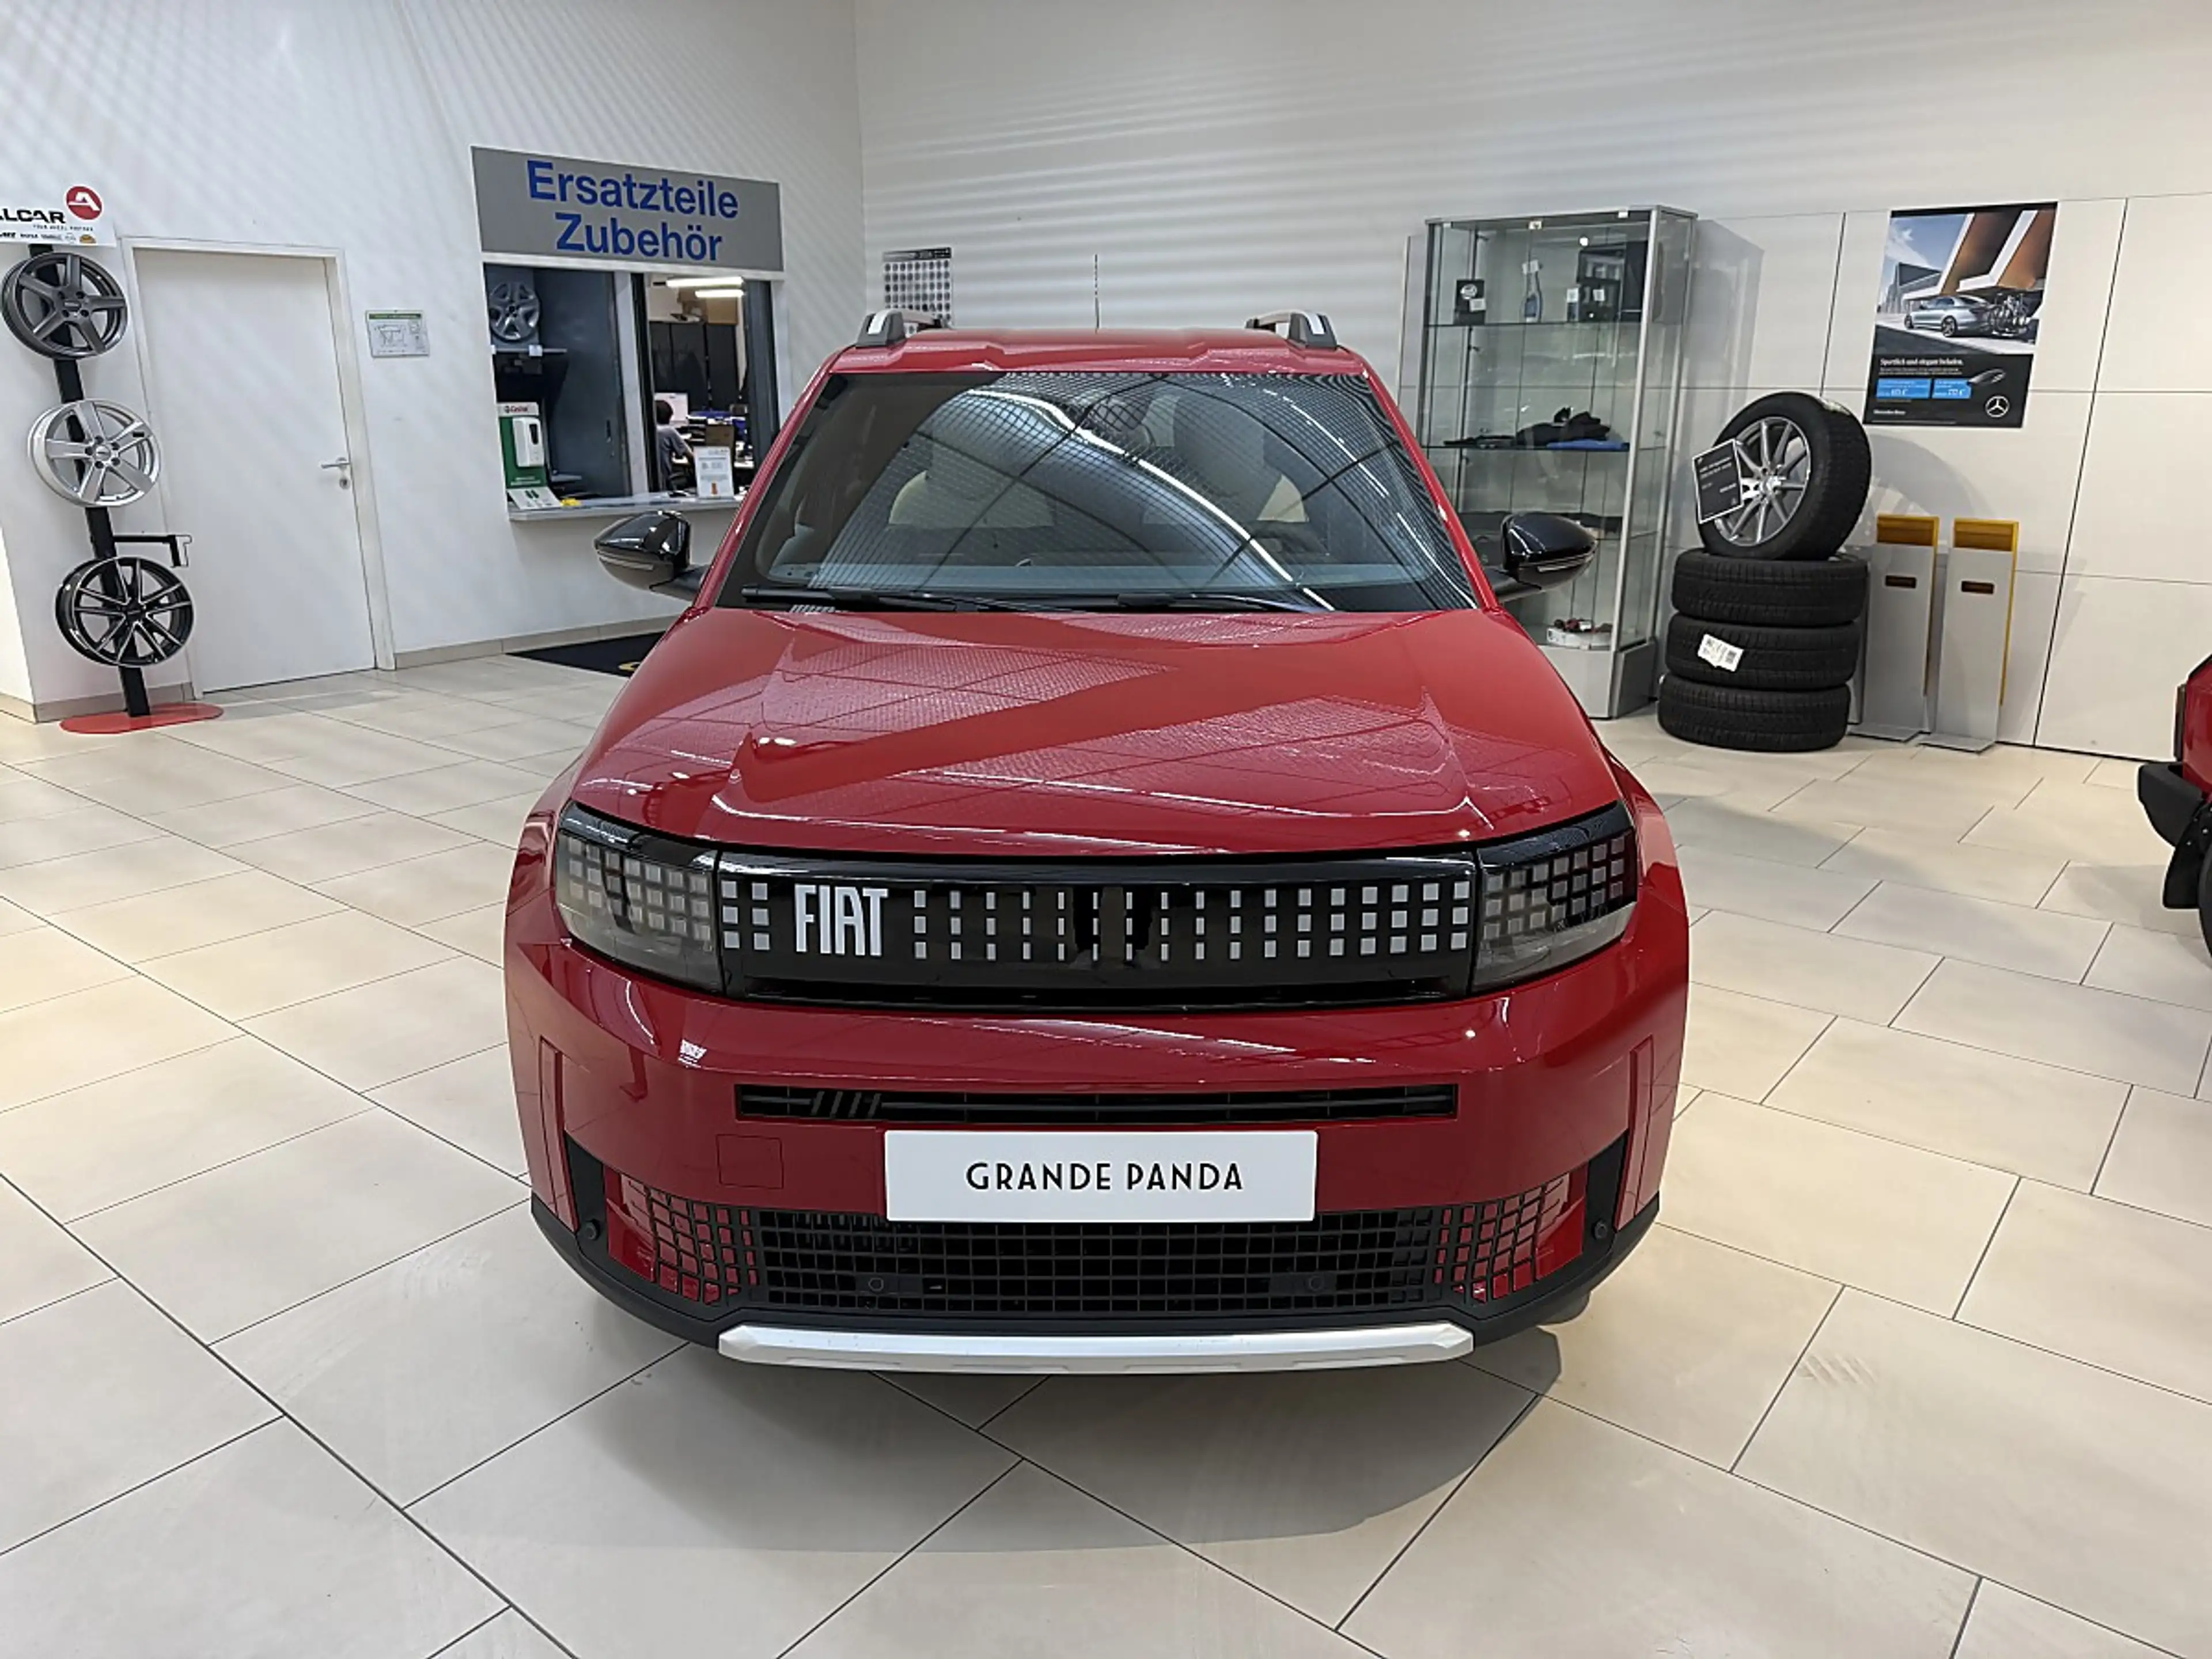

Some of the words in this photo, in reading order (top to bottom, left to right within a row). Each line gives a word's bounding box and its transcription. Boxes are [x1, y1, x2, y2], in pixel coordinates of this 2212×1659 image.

[527, 160, 738, 218] Ersatzteile
[0, 208, 66, 224] LCAR
[555, 213, 723, 260] Zubehör
[795, 884, 888, 956] FIAT
[965, 1162, 1111, 1190] GRANDE
[1127, 1162, 1243, 1190] PANDA
